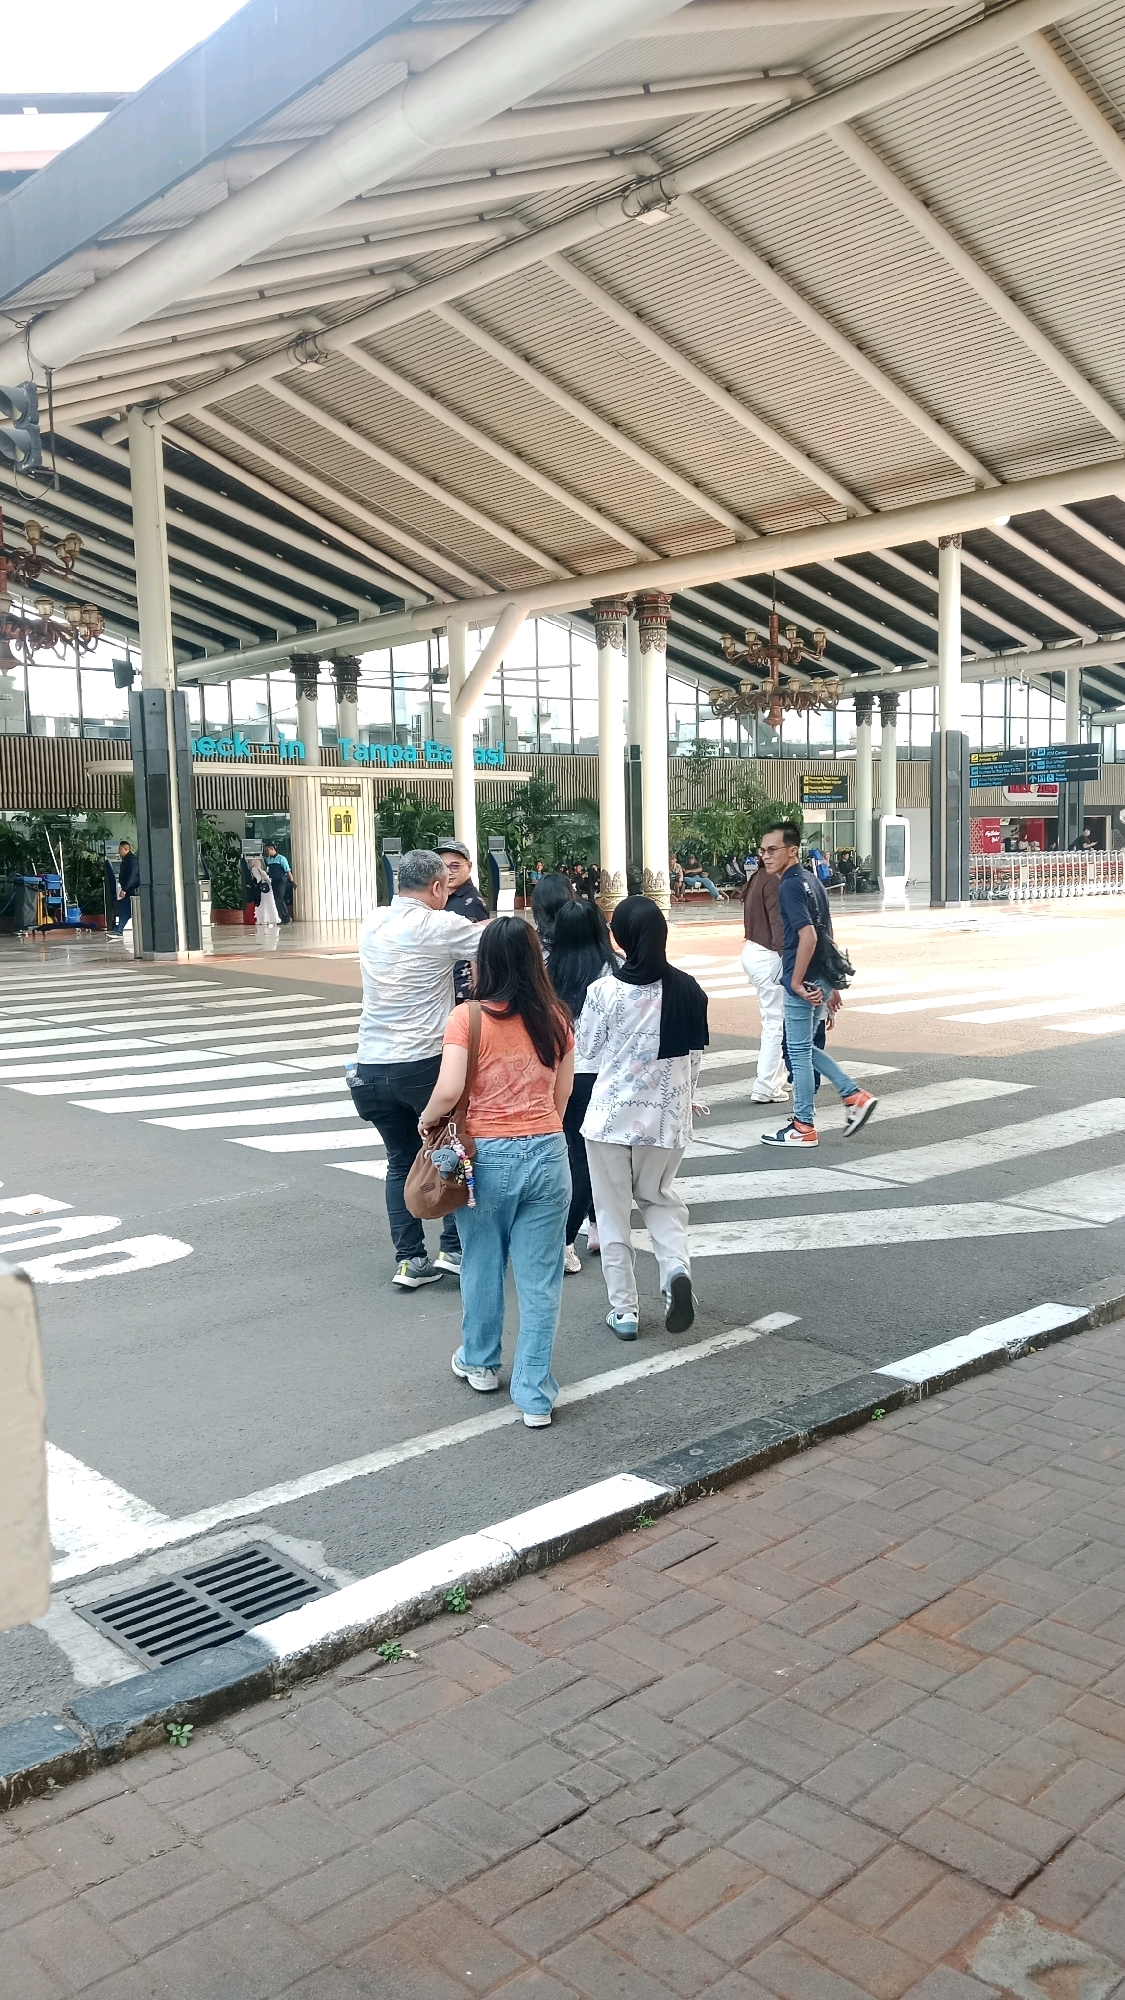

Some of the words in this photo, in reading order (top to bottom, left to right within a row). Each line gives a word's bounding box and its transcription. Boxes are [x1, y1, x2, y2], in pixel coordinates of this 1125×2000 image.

[278, 732, 305, 759] in
[337, 737, 417, 768] Tanpa
[424, 740, 504, 766] Baasi
